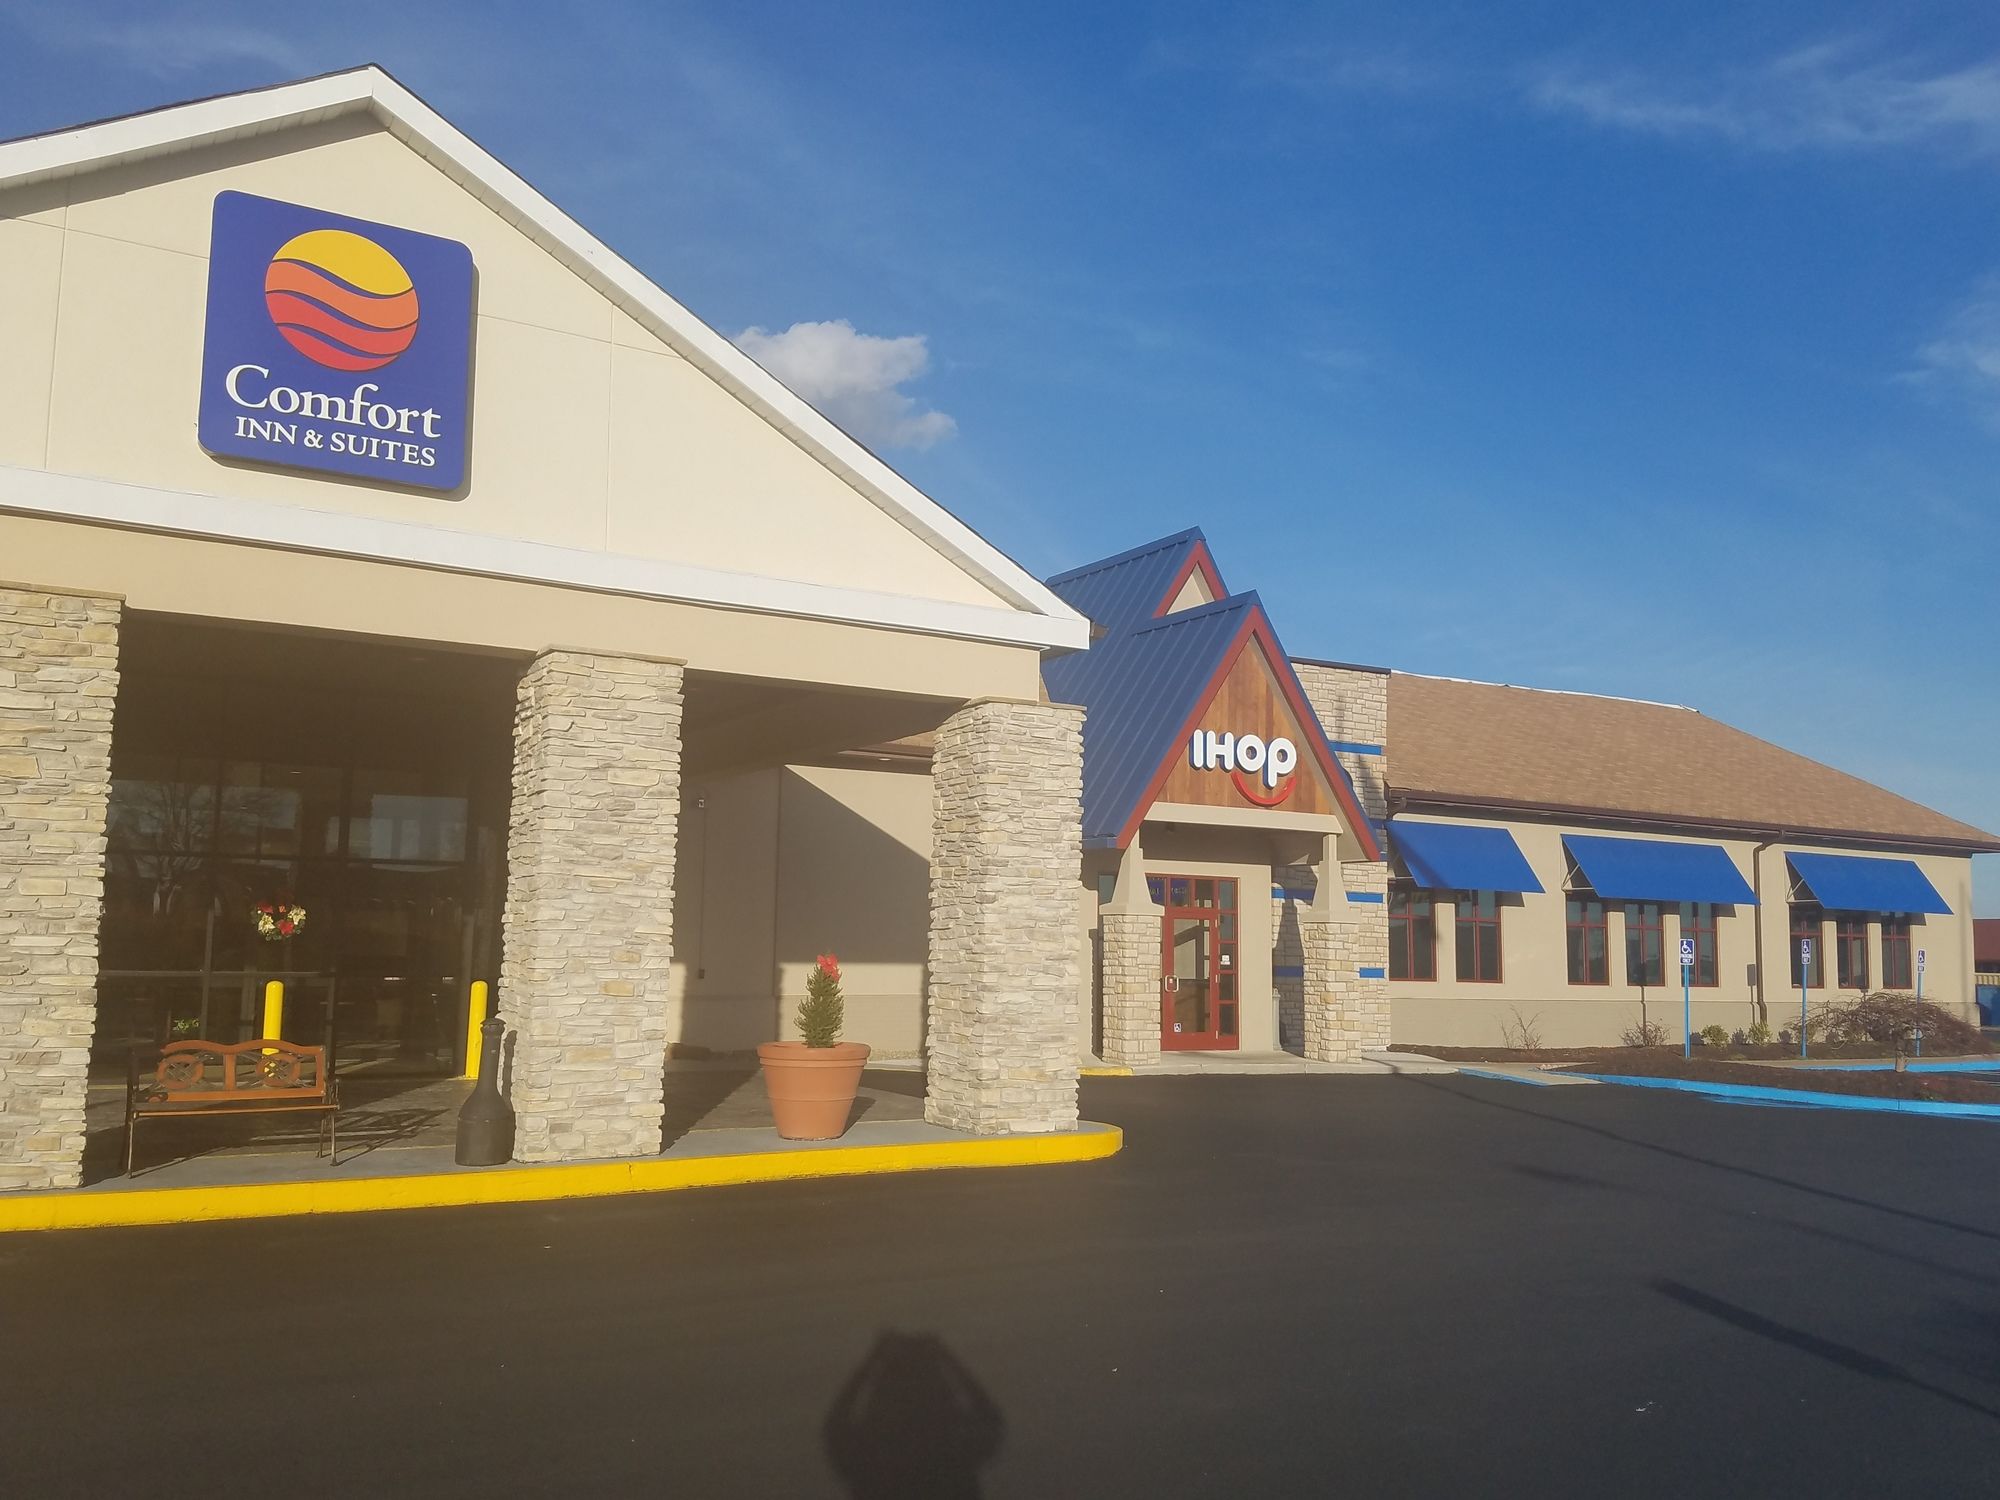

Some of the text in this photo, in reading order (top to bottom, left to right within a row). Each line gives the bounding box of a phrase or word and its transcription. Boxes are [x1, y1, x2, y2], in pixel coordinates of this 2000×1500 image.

[225, 364, 441, 438] Comfort
[235, 415, 436, 467] INN & SUITES
